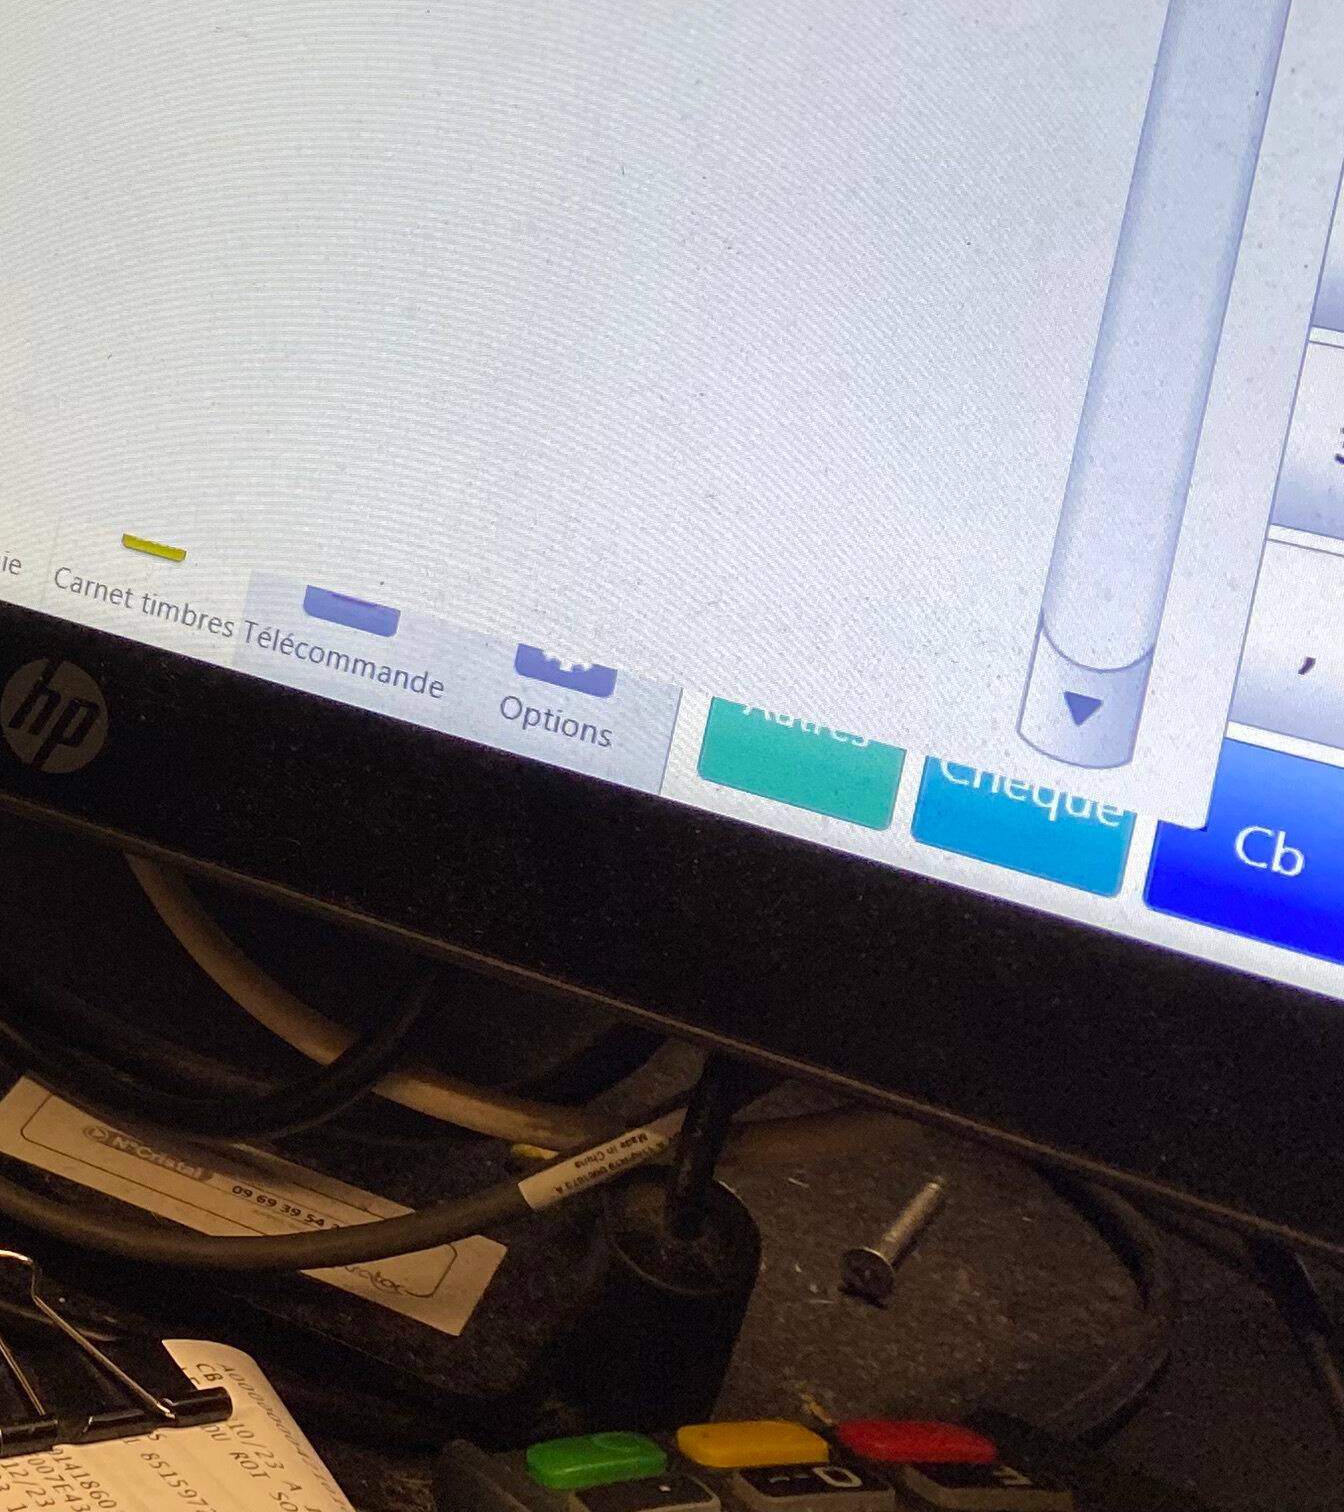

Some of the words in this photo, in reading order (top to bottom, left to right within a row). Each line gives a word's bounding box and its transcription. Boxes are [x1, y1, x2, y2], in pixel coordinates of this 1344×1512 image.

[53, 566, 134, 610] Carnet
[140, 591, 235, 641] timbres
[243, 619, 446, 701] Télécommande
[5, 659, 104, 774] hp
[499, 694, 613, 749] Options
[1234, 825, 1306, 878] Cb
[196, 1362, 224, 1382] CB
[229, 1450, 271, 1480] ROI
[283, 1479, 303, 1492] A
